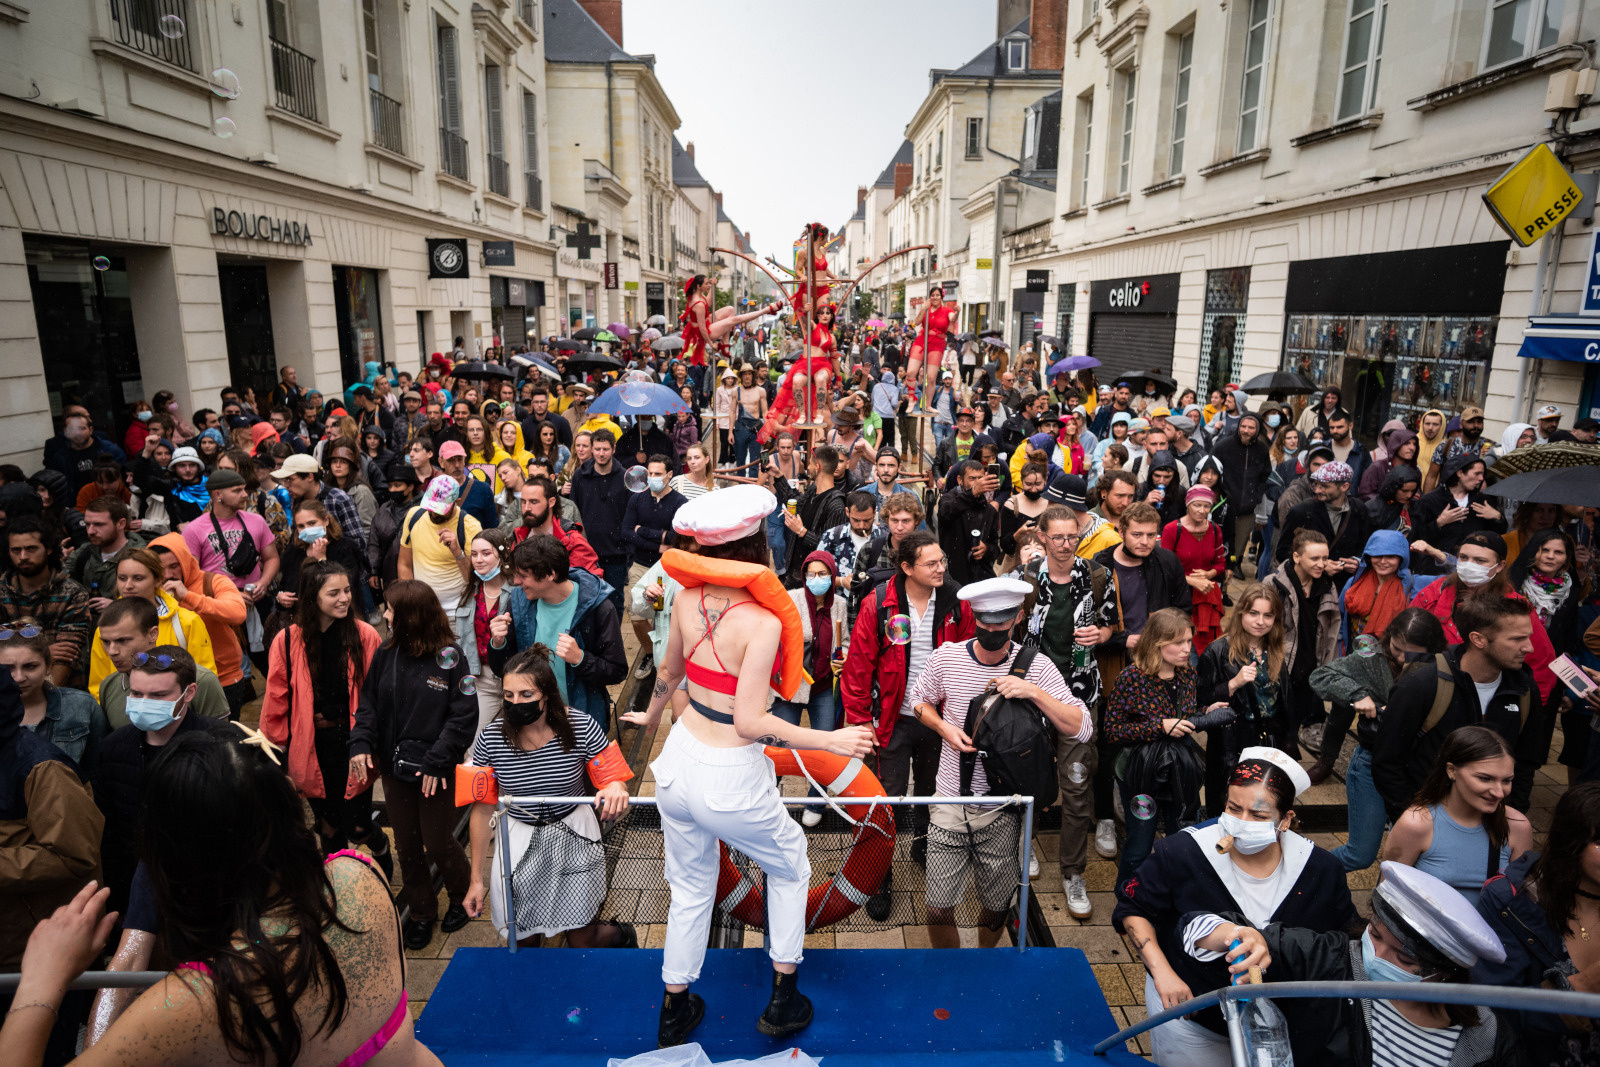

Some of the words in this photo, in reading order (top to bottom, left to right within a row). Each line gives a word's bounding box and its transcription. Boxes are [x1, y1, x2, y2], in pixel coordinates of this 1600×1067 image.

[1524, 187, 1578, 238] PRESSE
[213, 207, 313, 246] BOUCHARA
[608, 263, 616, 288] Burton
[1109, 281, 1141, 307] celio
[476, 776, 485, 798] INTEX
